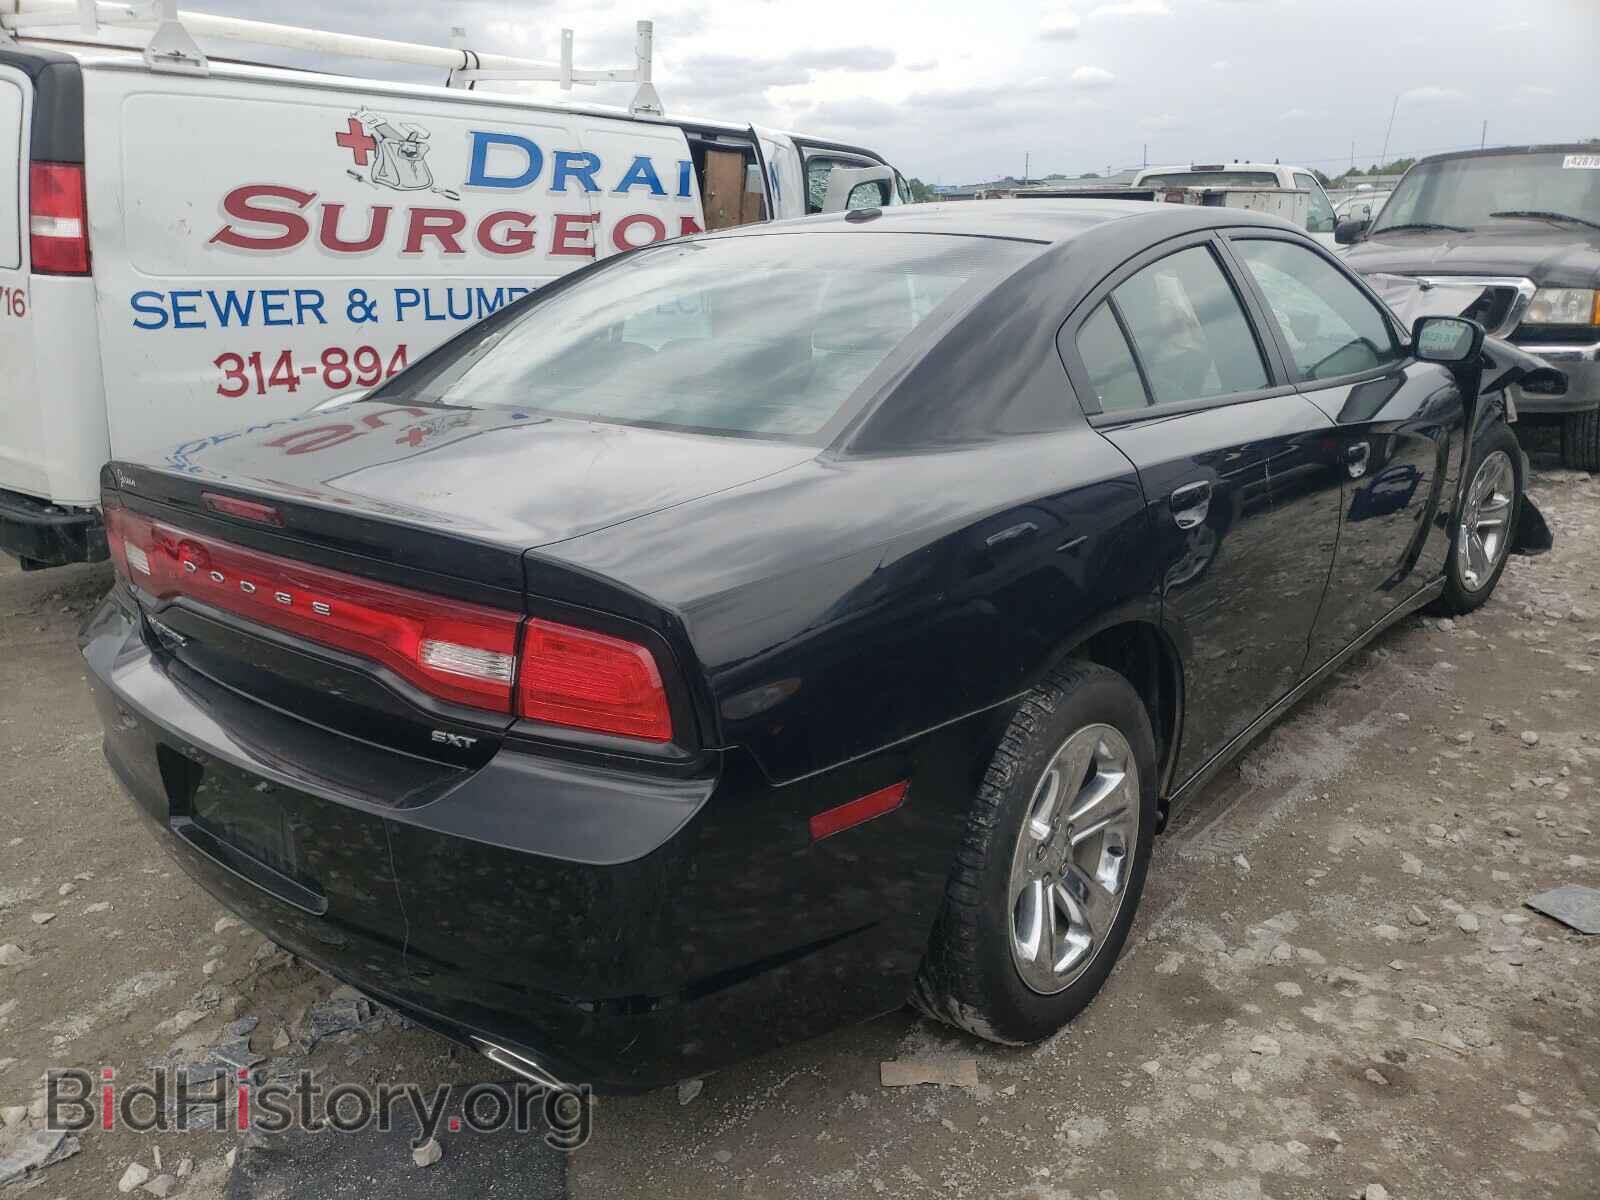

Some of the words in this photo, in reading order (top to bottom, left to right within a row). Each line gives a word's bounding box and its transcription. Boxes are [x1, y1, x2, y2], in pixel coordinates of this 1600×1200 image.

[0, 285, 26, 318] 16
[130, 288, 328, 330] SEWER
[346, 288, 378, 323] &
[213, 344, 408, 398] 314-894
[183, 560, 331, 616] DODGE
[431, 730, 478, 749] SXT
